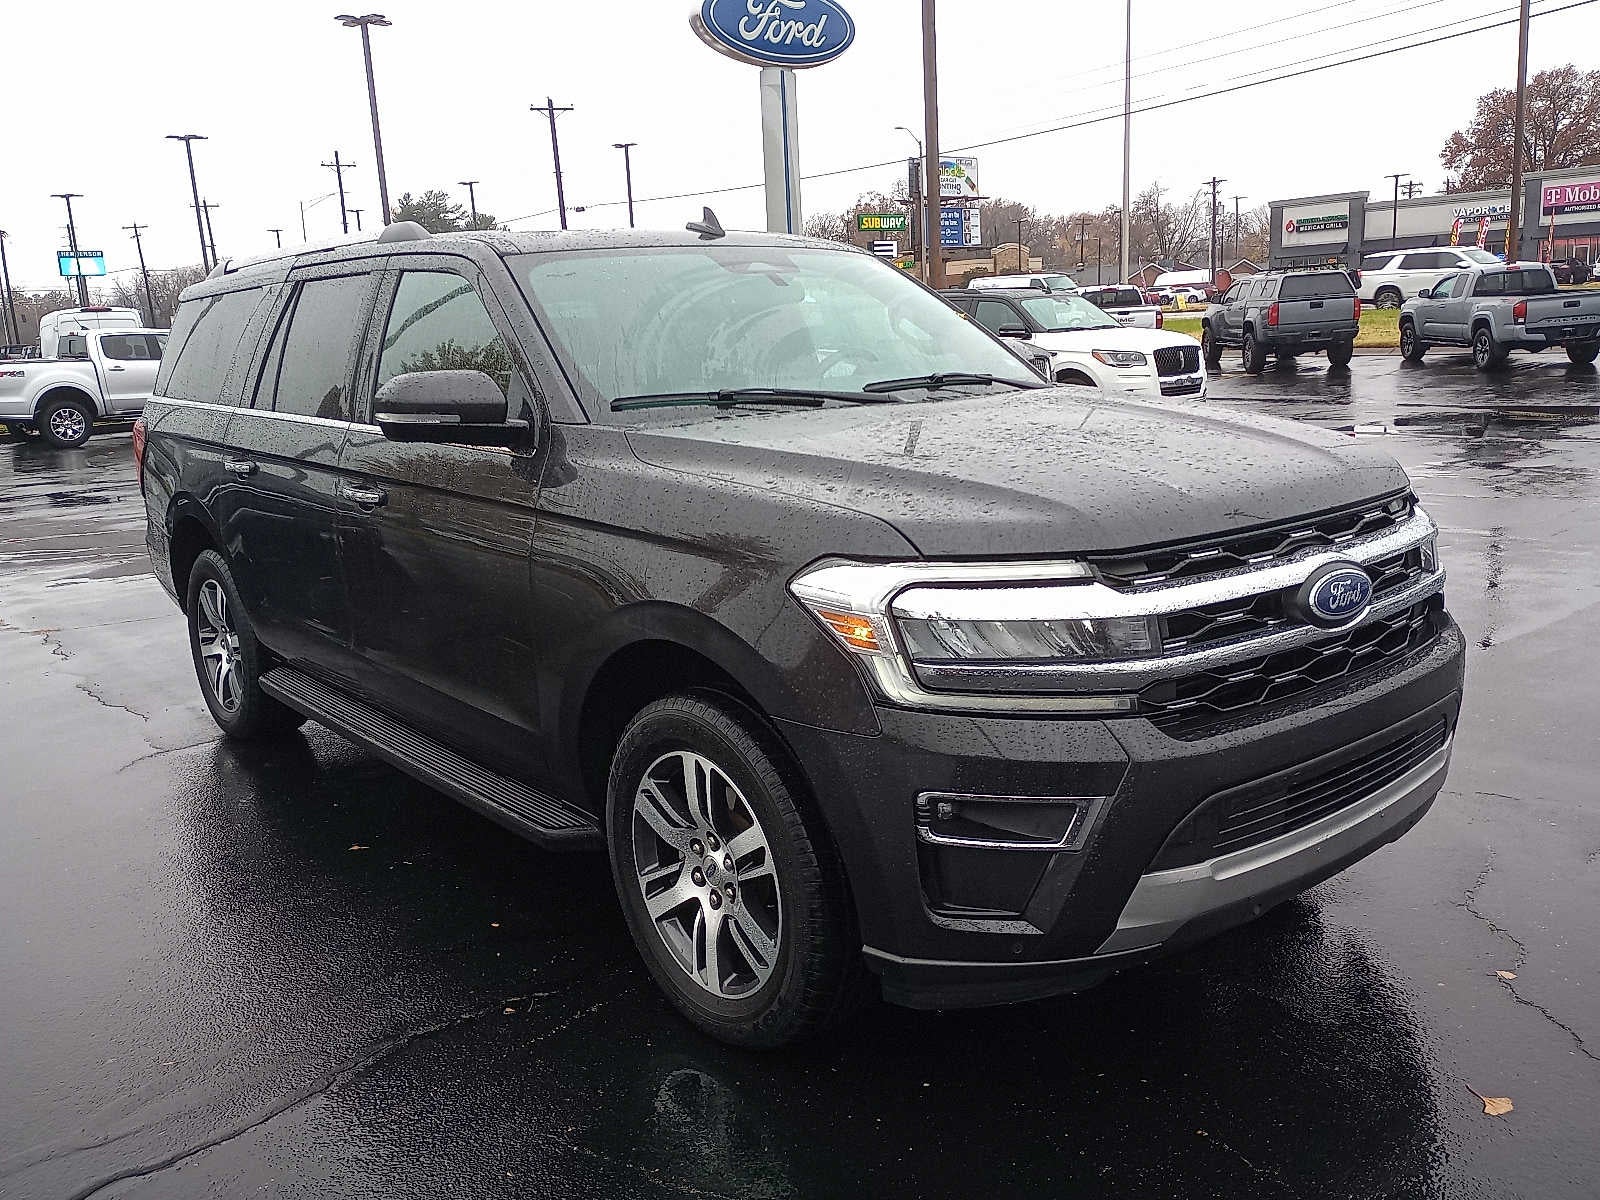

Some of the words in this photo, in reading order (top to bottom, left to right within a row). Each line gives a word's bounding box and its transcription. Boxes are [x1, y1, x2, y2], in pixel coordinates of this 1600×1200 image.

[738, 0, 828, 48] Ford
[1452, 206, 1489, 217] VAPOR
[1563, 204, 1597, 212] AUTHORIZED
[861, 217, 905, 229] SUBWAY
[1299, 223, 1325, 232] MEXICAN
[1329, 578, 1362, 610] Ford
